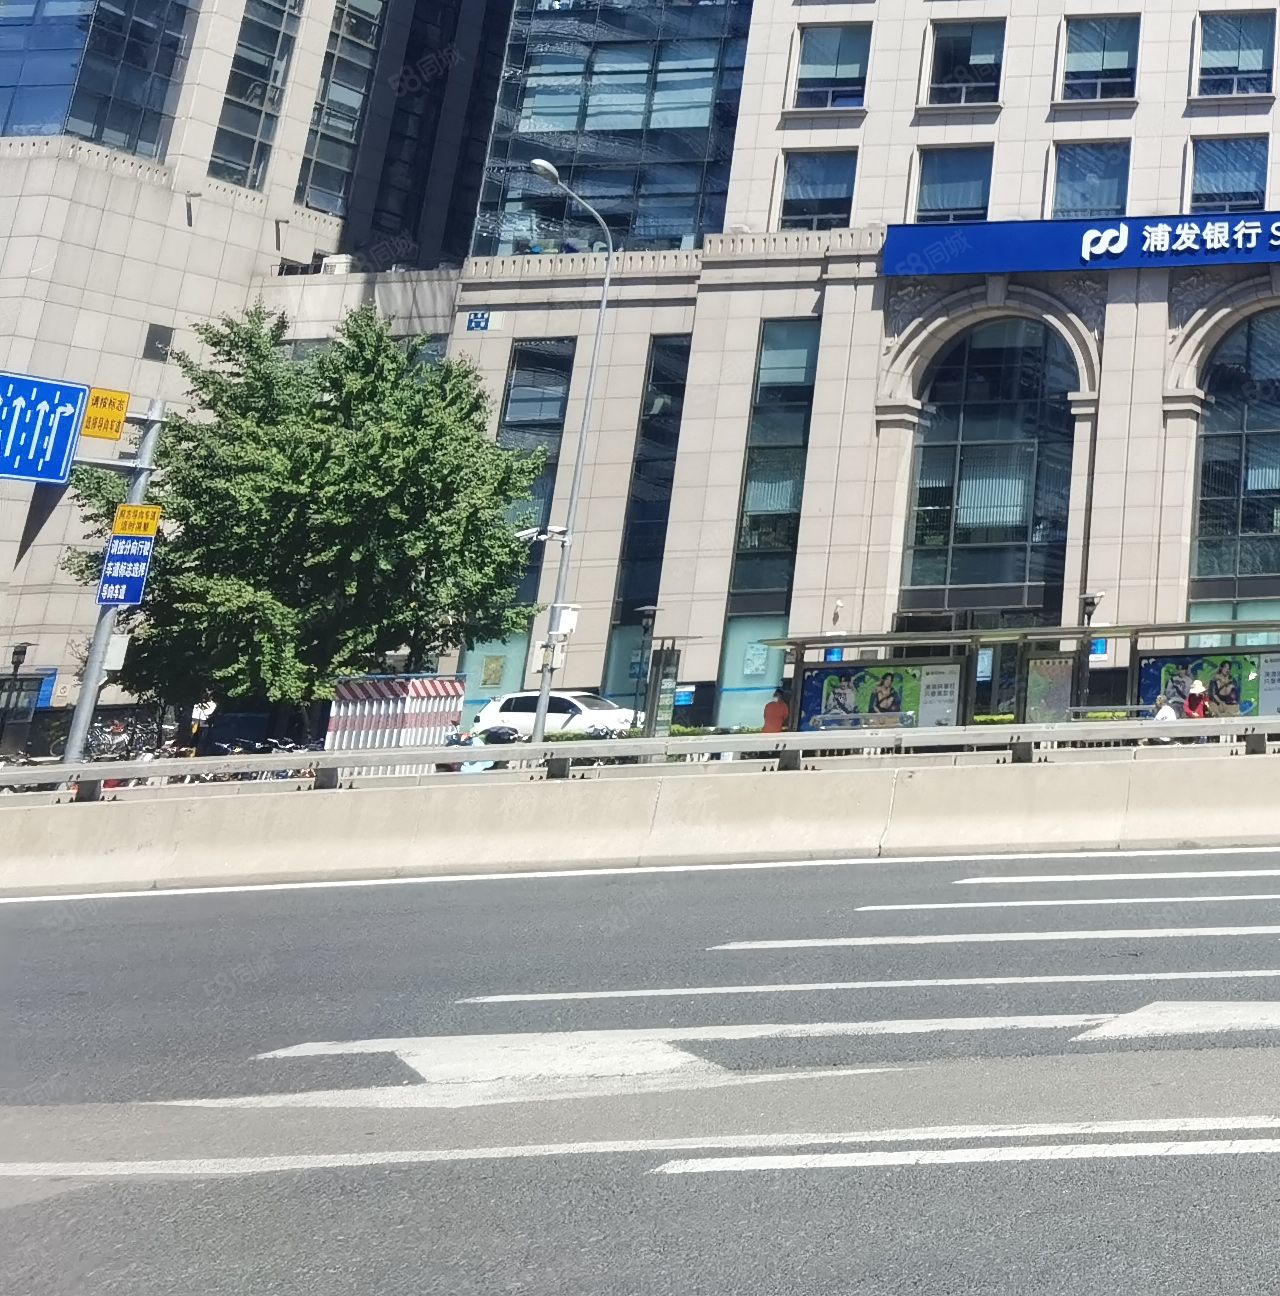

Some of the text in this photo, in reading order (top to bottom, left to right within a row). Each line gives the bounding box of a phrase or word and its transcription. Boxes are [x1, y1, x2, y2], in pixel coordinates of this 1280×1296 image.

[1142, 219, 1262, 252] 浦发银行
[91, 395, 126, 412] 请按标志
[105, 561, 147, 578] 车道标志选择
[101, 583, 127, 600] 导向车道
